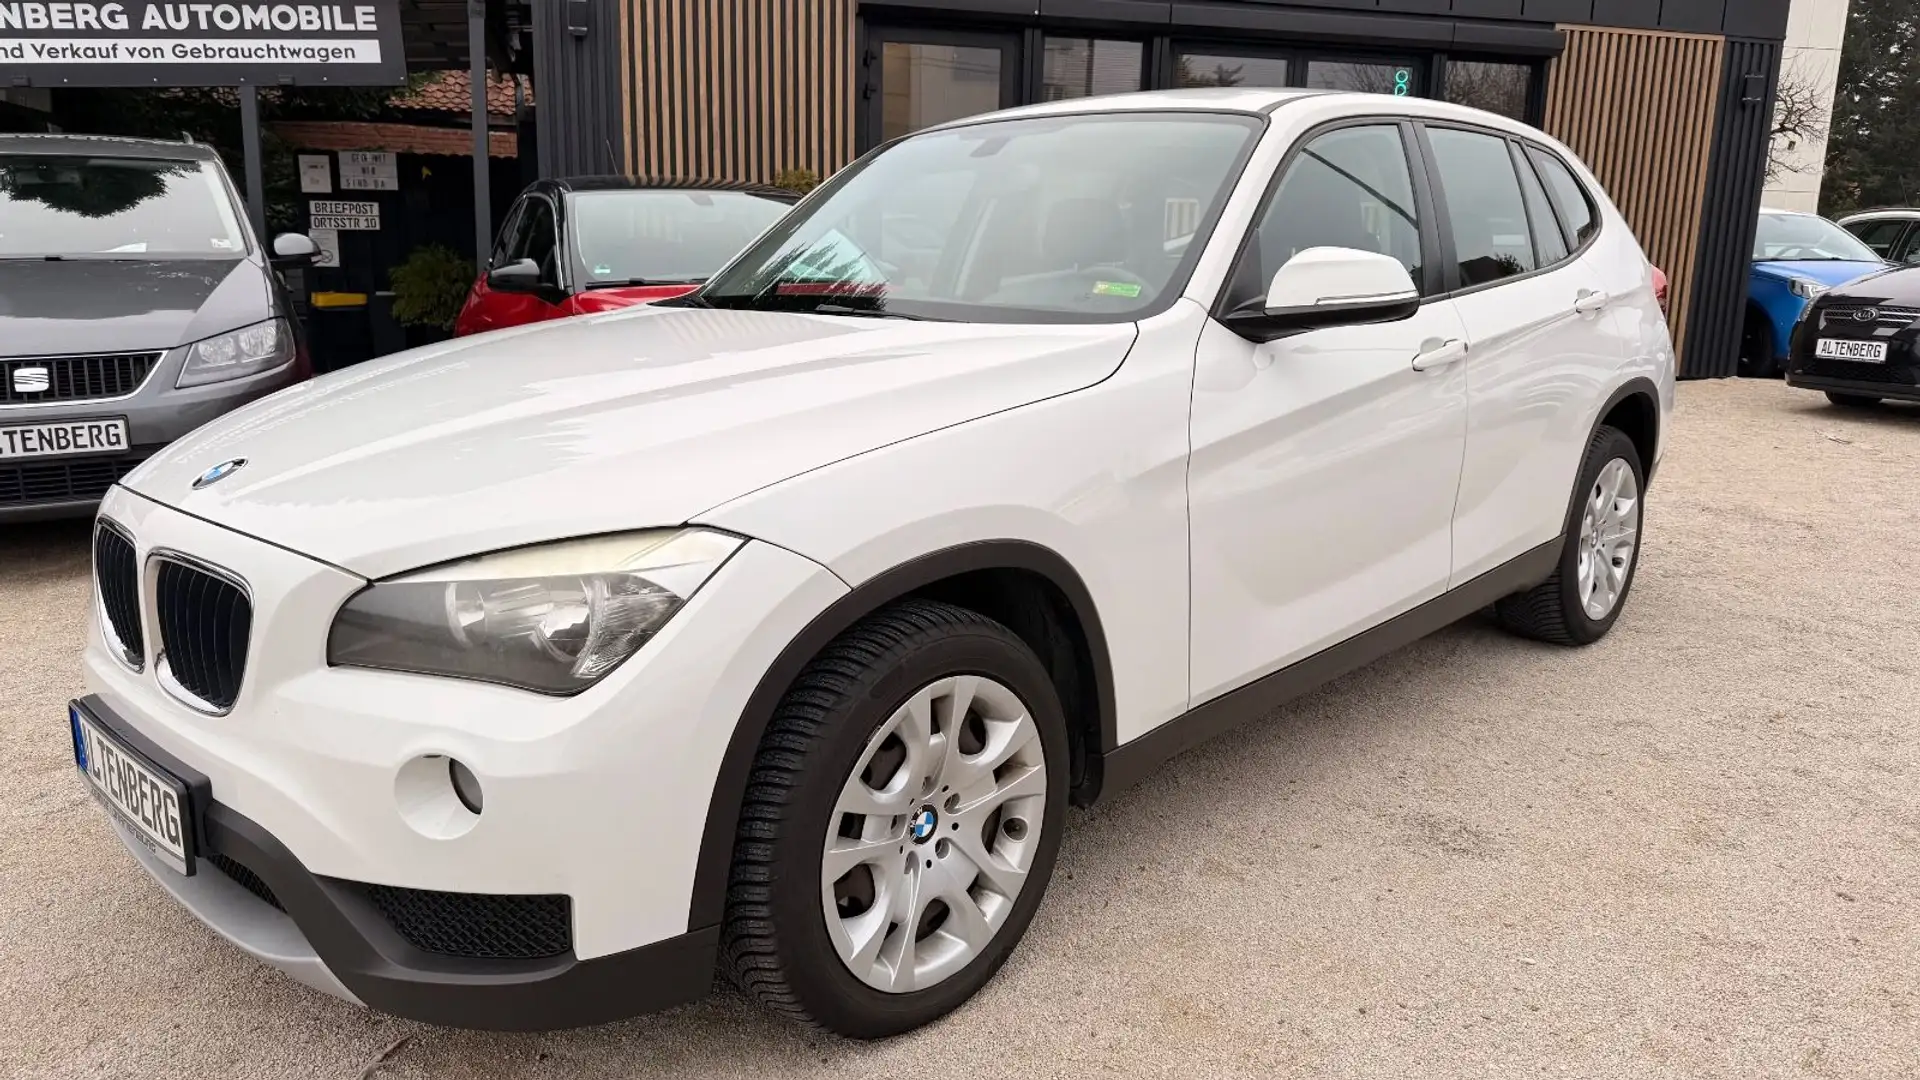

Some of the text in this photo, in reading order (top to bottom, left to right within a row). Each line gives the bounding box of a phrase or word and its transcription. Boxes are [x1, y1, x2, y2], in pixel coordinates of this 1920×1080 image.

[142, 4, 378, 31] AUTOMOBILE
[30, 43, 118, 59] Verkauf
[125, 46, 165, 59] von
[171, 43, 356, 62] Gebrauchtwagen
[314, 202, 375, 214] BRIEFPOST
[313, 217, 377, 229] ORTSSTR 10
[1821, 341, 1882, 358] ALTENBERG
[0, 423, 122, 455] TENBERG
